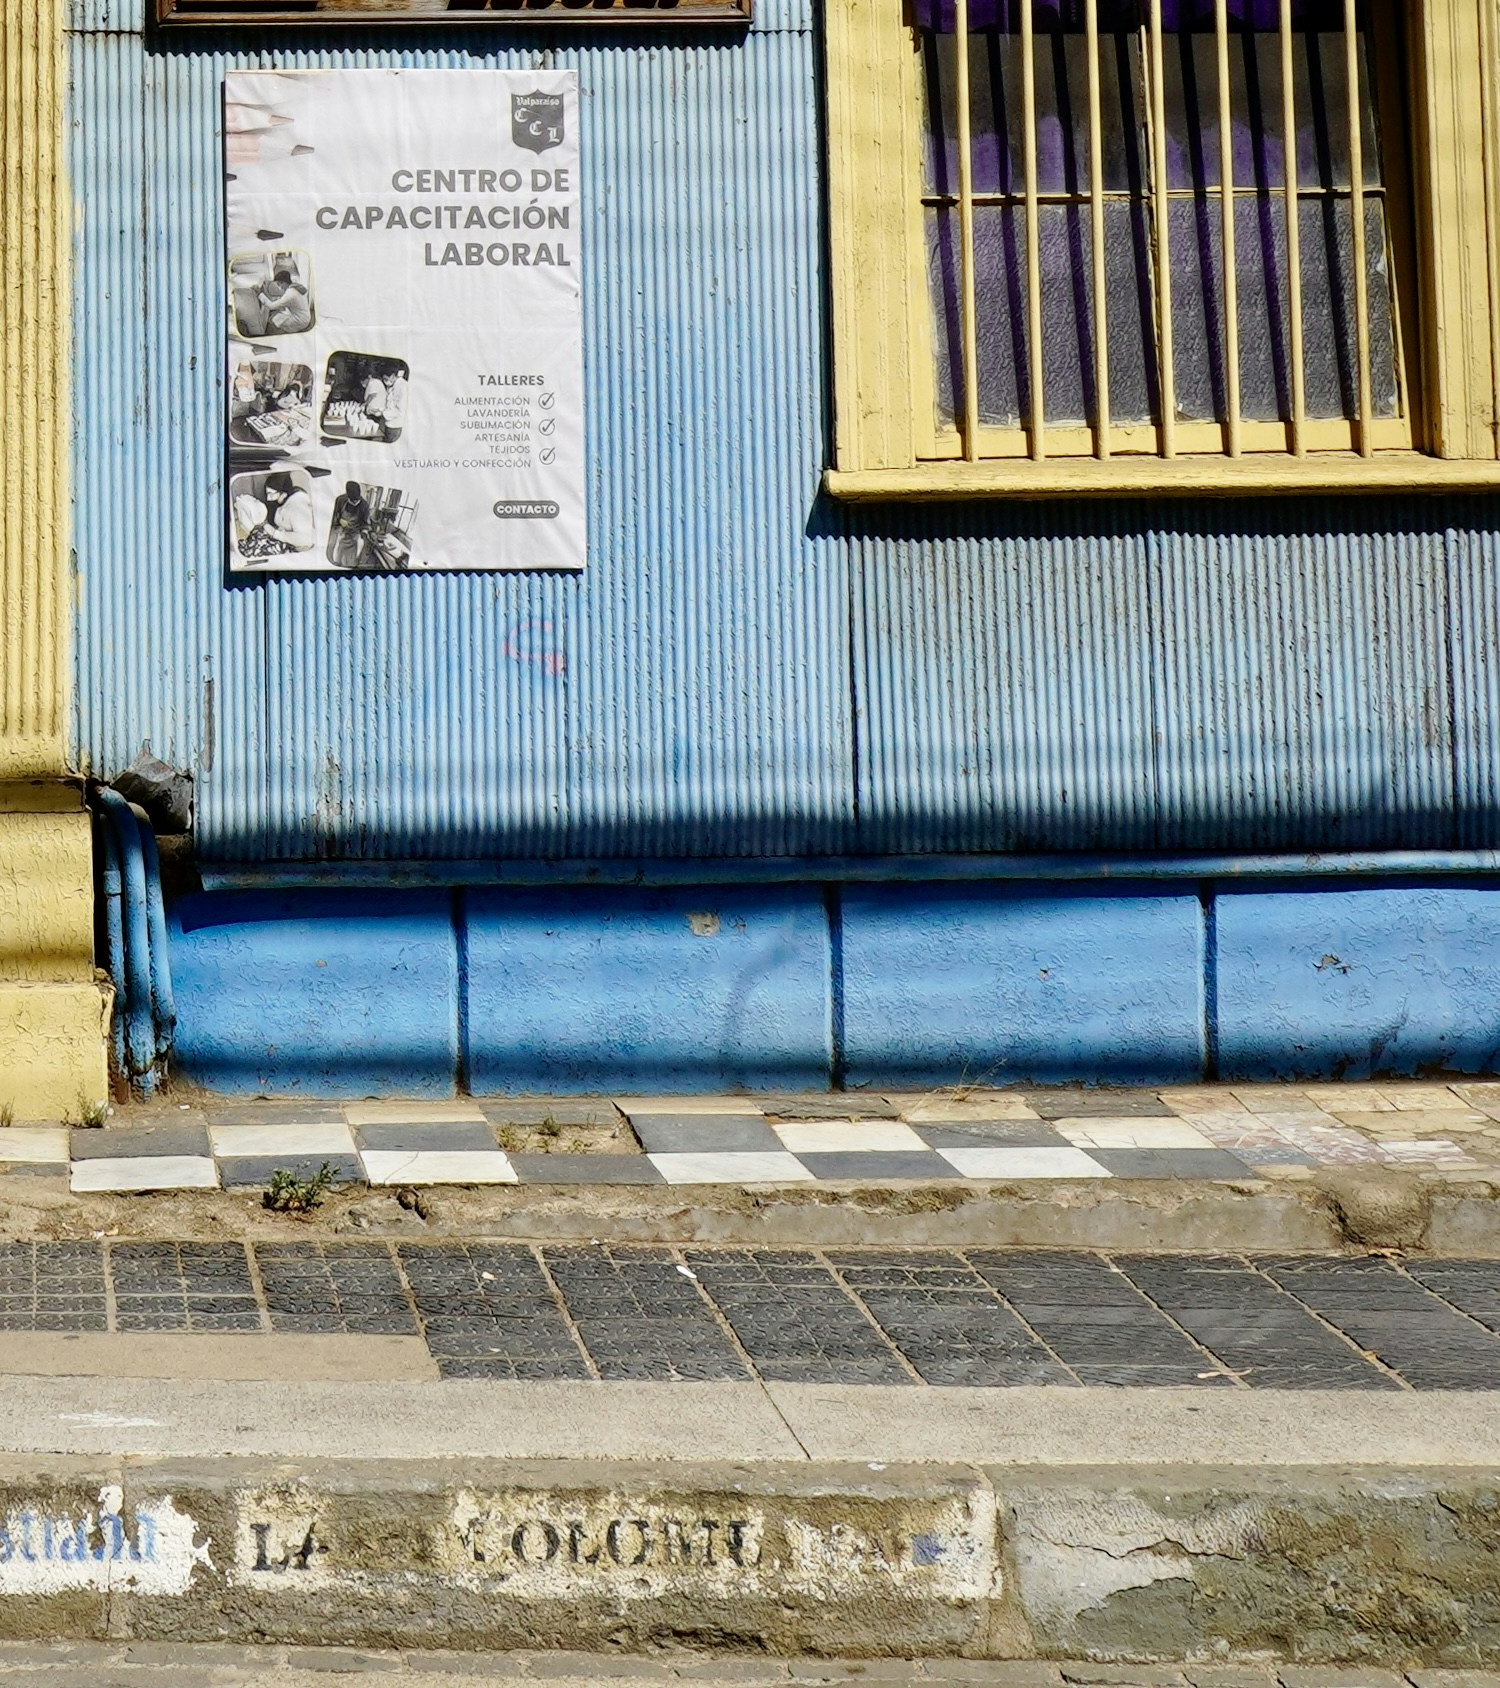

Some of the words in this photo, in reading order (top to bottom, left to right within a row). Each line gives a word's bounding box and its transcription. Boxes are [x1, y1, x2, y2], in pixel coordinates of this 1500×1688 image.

[392, 169, 523, 193] CENTRO
[531, 169, 570, 192] DE
[316, 198, 570, 230] CAPACITACIÓN
[425, 243, 571, 267] LABORAL
[478, 375, 545, 386] TALLERES
[455, 396, 531, 406] ALIMENTACIÓN
[467, 408, 531, 418] LAVANDERÍA
[460, 420, 531, 430] SUBLIMACIÓN
[475, 432, 531, 442] ARTESANÍA
[490, 446, 531, 455] TEJIDOS
[394, 459, 451, 468] VESTUARIO
[454, 459, 460, 468] Y
[462, 457, 531, 468] CONFECCIÓN
[496, 505, 557, 514] CONTACTO
